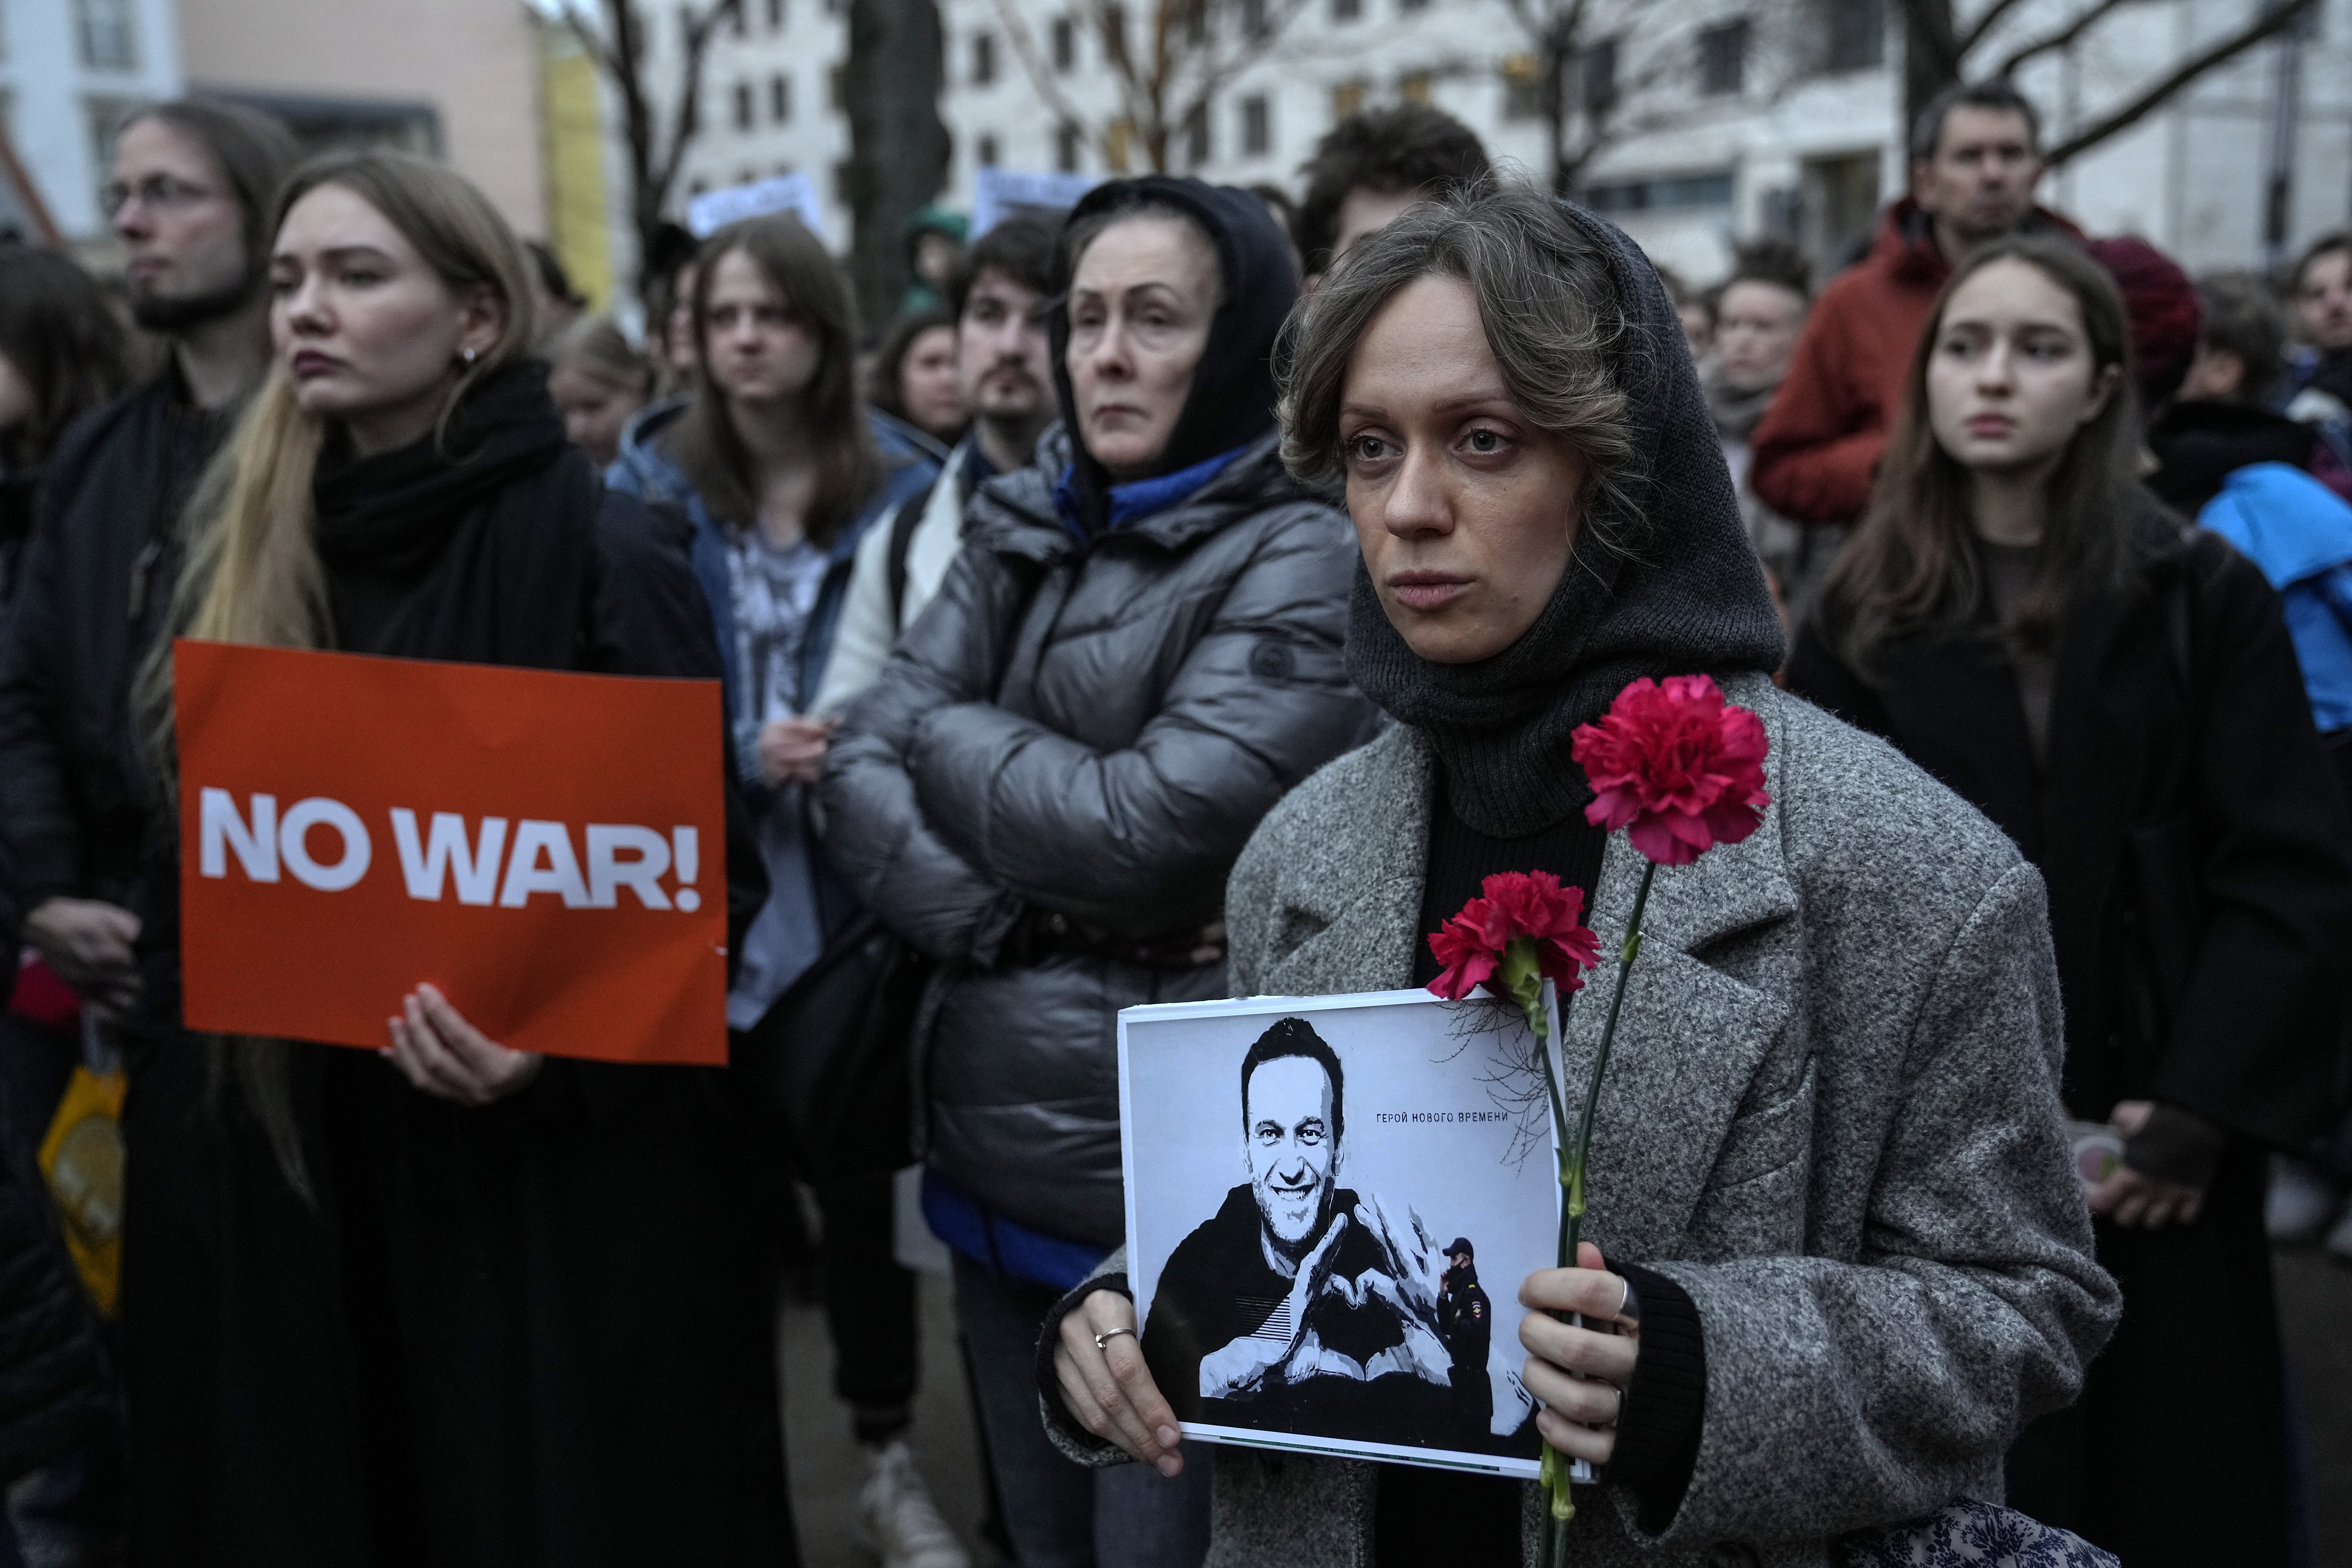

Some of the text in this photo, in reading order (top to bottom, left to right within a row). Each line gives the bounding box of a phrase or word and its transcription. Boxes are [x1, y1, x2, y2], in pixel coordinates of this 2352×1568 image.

[200, 786, 701, 913] NO WAR!
[1376, 1112, 1508, 1123] ГЕРОЙ НОВОГО ВРЕМЕНИ
